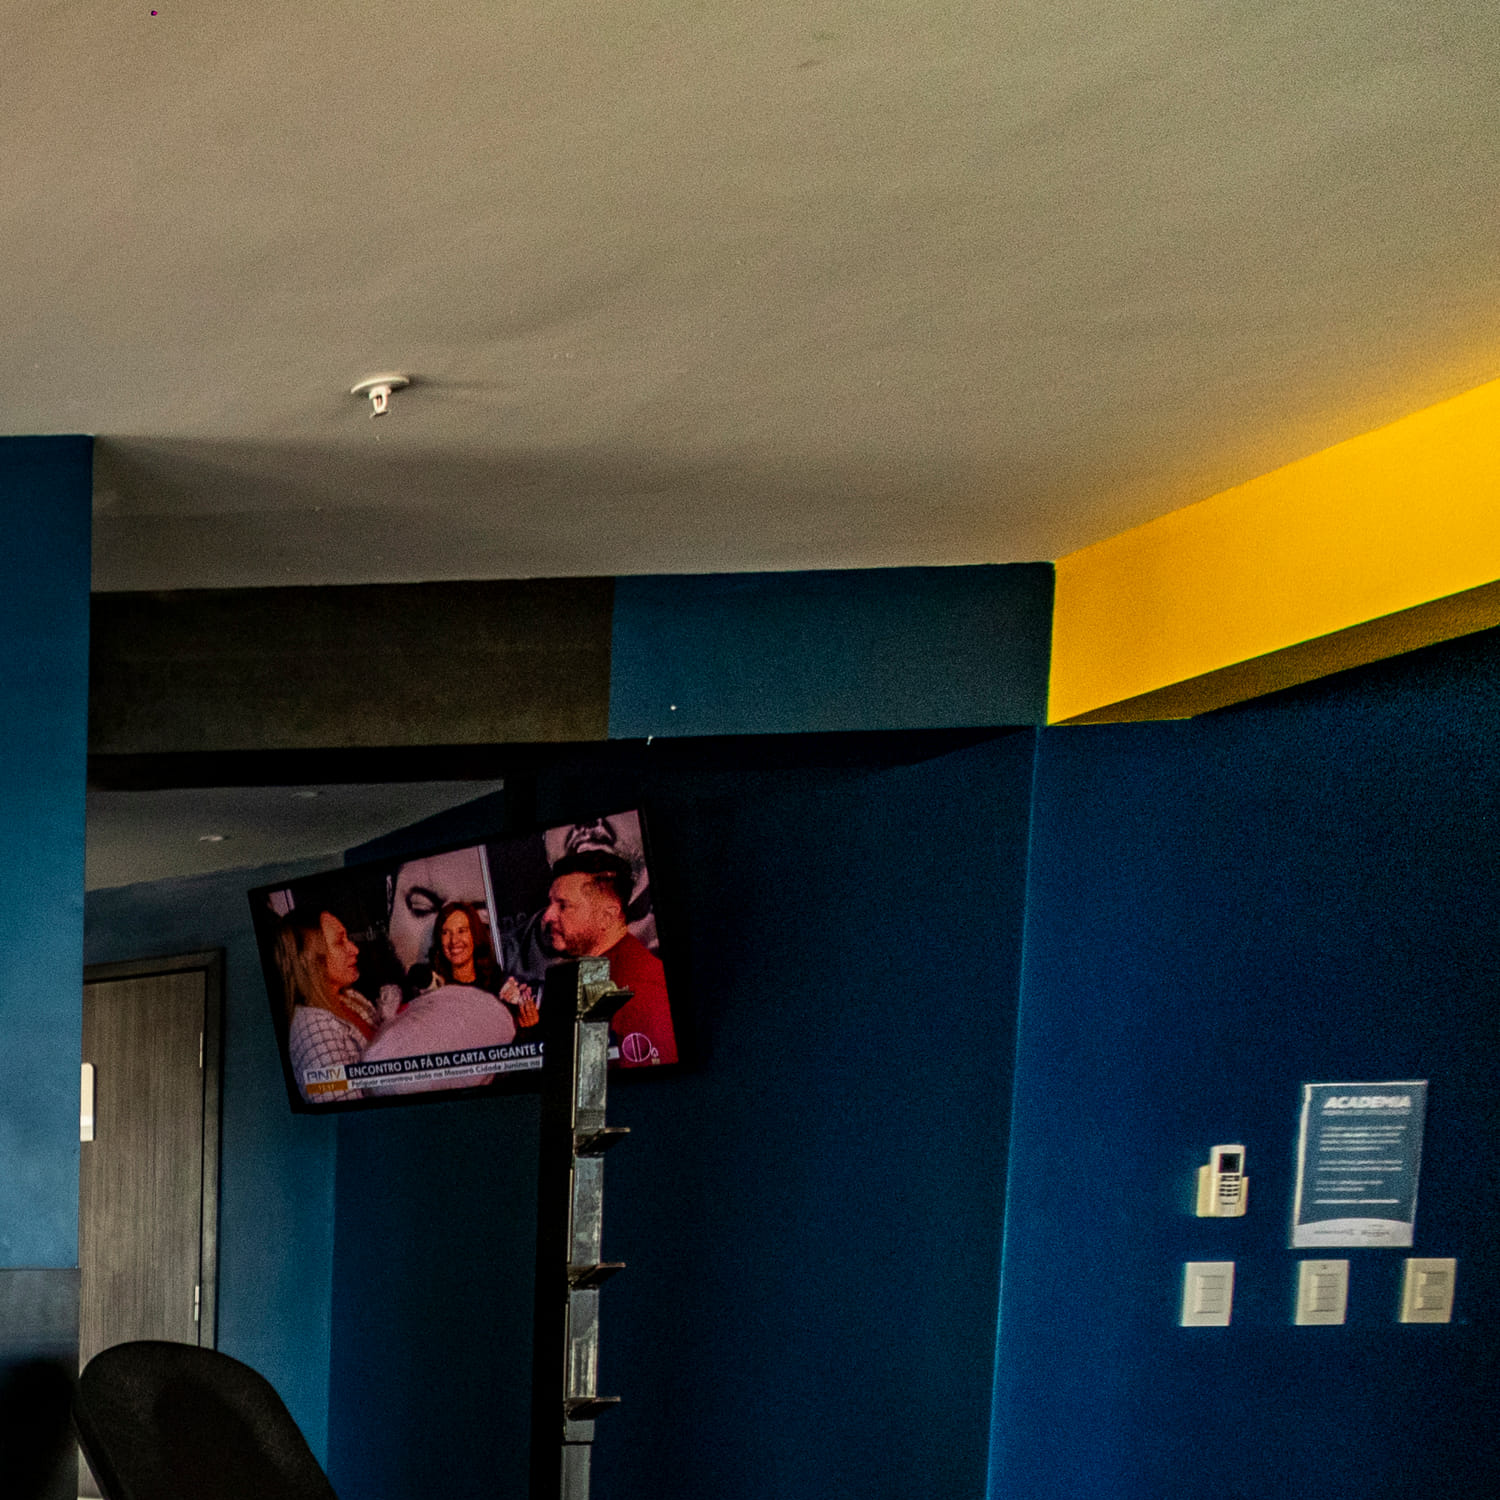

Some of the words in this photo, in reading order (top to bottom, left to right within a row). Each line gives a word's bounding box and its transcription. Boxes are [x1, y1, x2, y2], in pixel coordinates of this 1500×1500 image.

[348, 1061, 402, 1078] ENCONTRO
[404, 1059, 419, 1072] DA
[435, 1055, 451, 1068] DA
[453, 1050, 486, 1065] CARTA
[488, 1044, 537, 1061] GIGANTE
